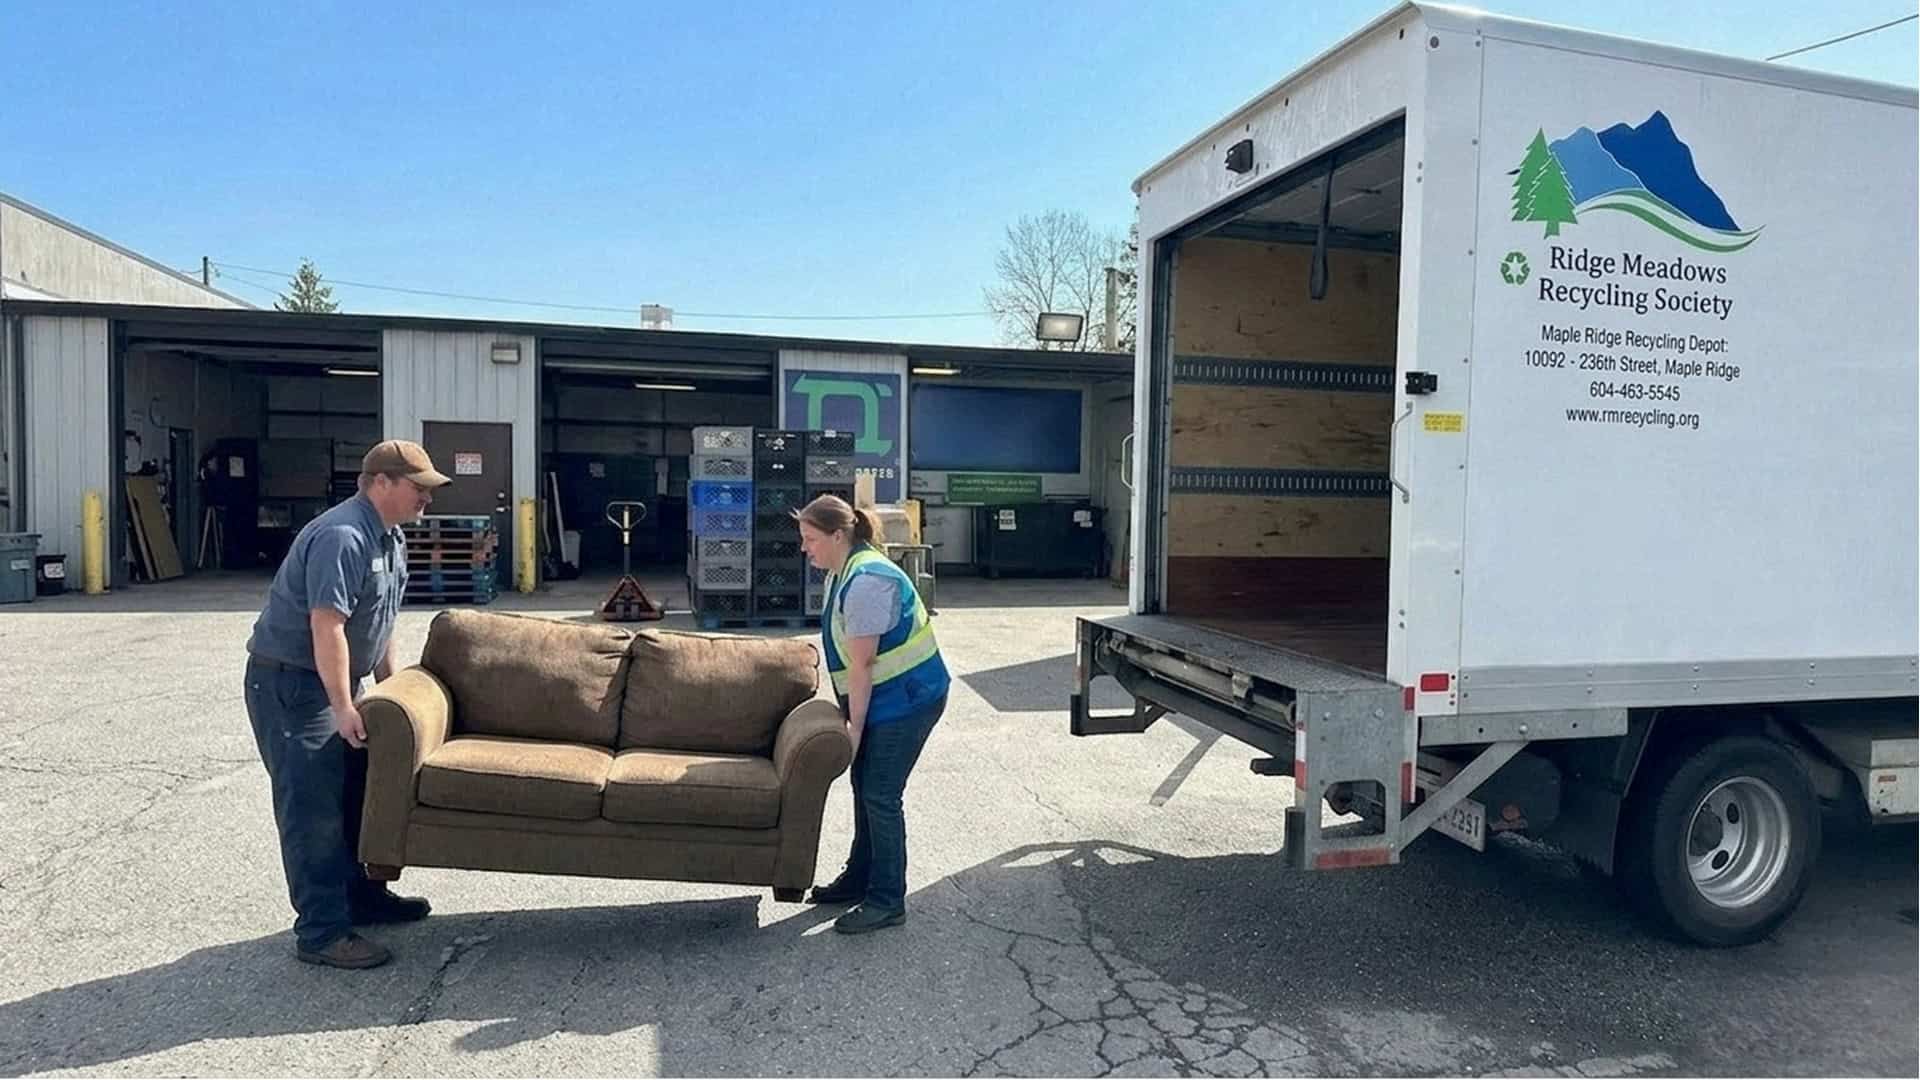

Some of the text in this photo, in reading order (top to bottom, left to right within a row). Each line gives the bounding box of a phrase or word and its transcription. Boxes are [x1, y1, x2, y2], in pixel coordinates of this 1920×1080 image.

[1550, 246, 1727, 284] Ridge Meadows
[1539, 278, 1733, 321] Recycling Society
[1541, 324, 1729, 355] Maple Ridge Recycling Depot:
[1525, 350, 1566, 368] 10092
[1579, 353, 1616, 370] 236th
[1619, 355, 1662, 376] Street,
[1664, 358, 1702, 378] Maple
[1705, 361, 1741, 381] Ridge
[1590, 381, 1681, 401] 604-463-5545
